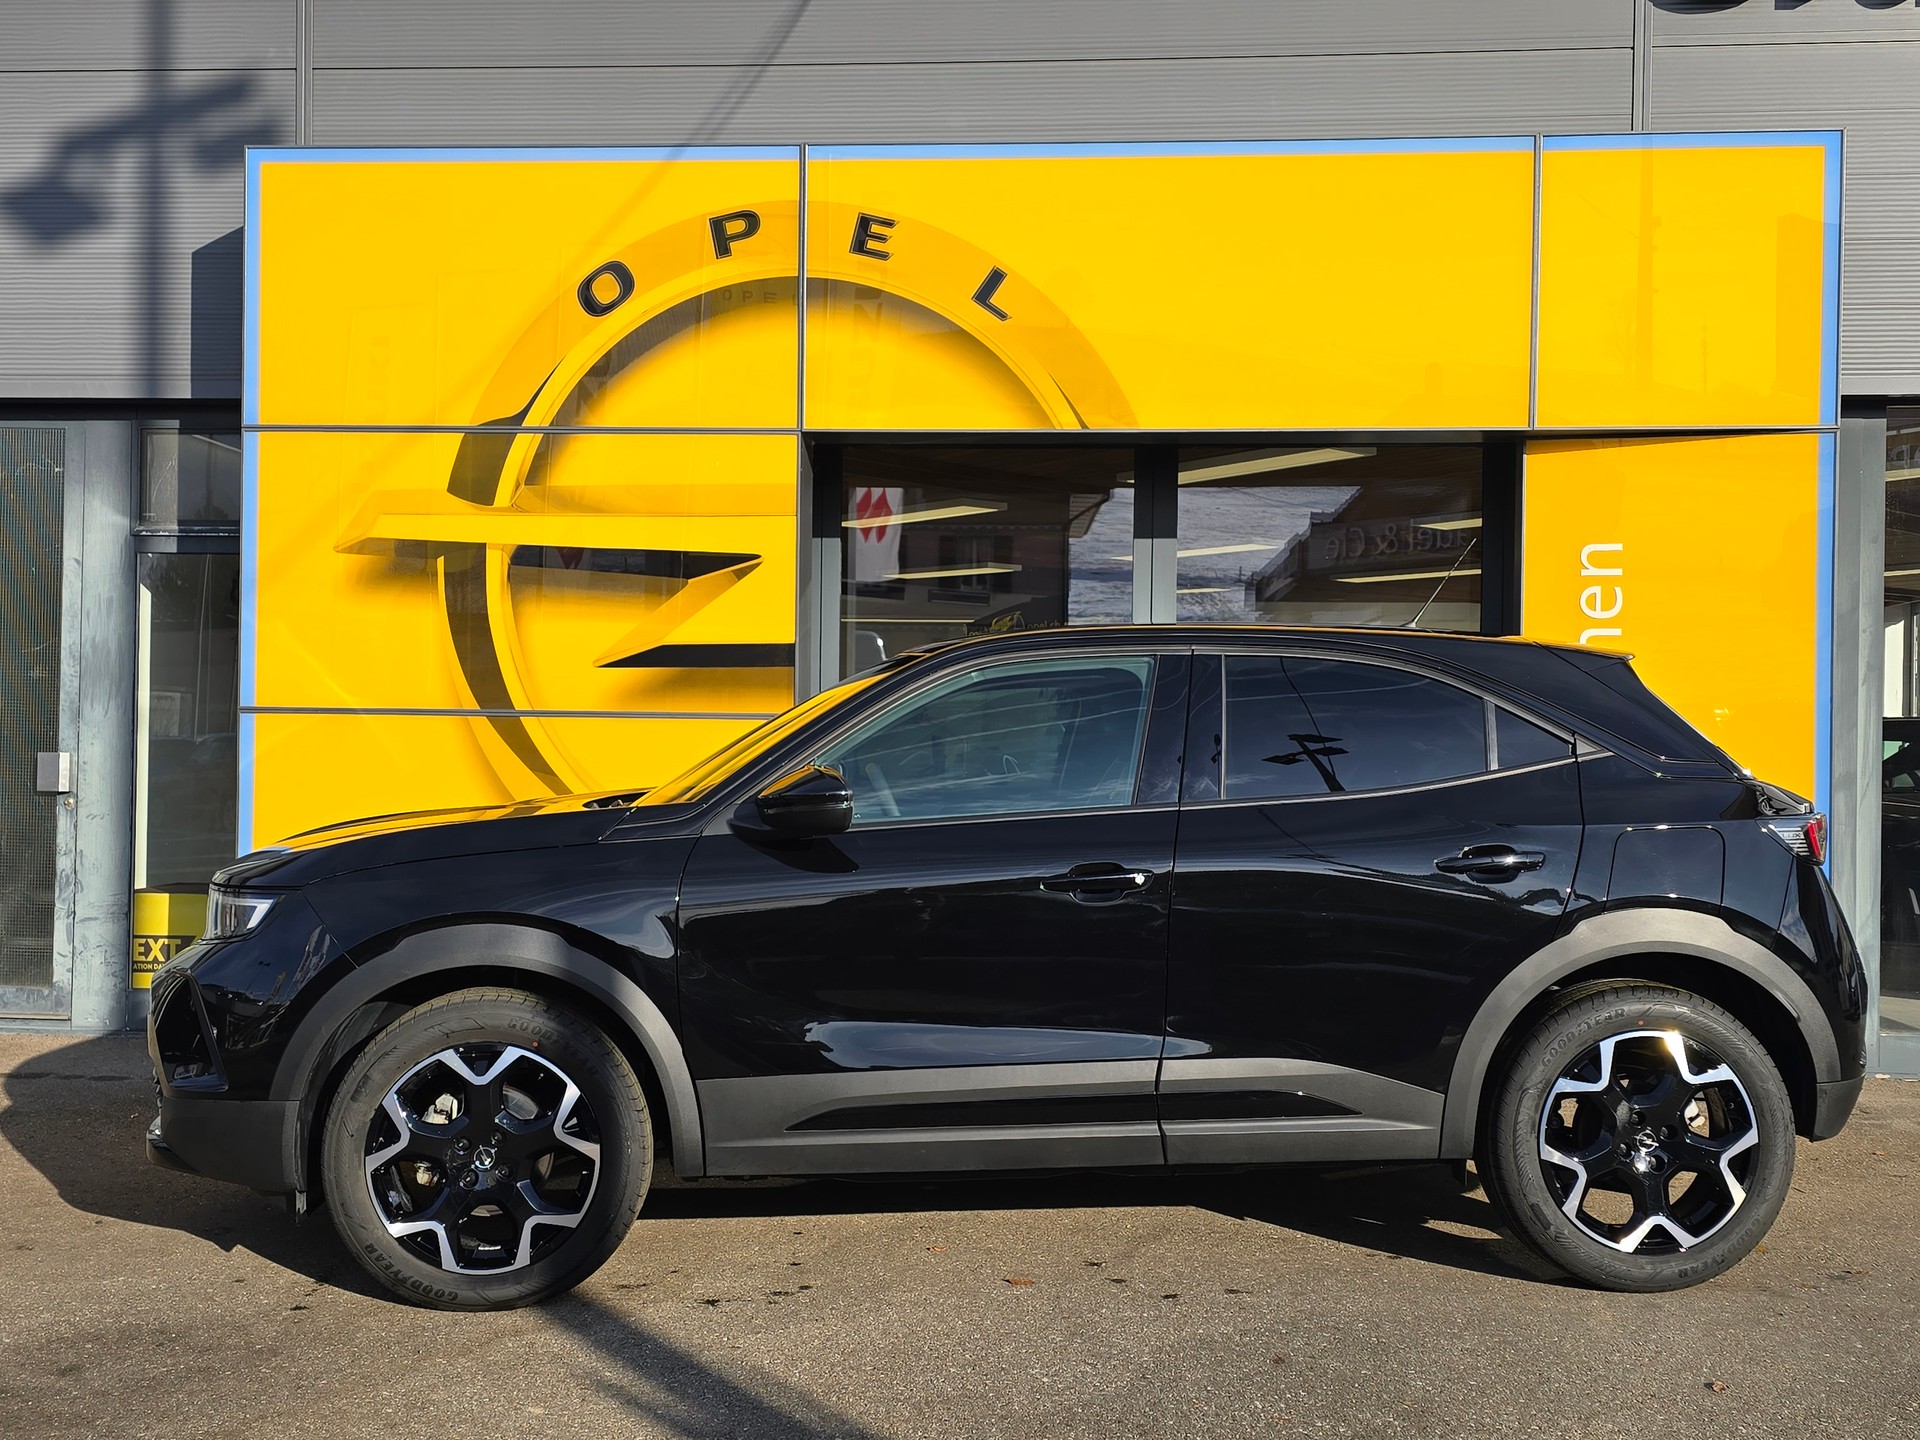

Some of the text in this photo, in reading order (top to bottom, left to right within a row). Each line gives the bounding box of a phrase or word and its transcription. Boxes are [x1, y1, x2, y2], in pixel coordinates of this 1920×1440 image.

[576, 209, 1012, 321] OPEL
[133, 938, 181, 962] EXT
[1541, 1007, 1626, 1067] GOODYEAR
[363, 1242, 460, 1301] GOODYEAR
